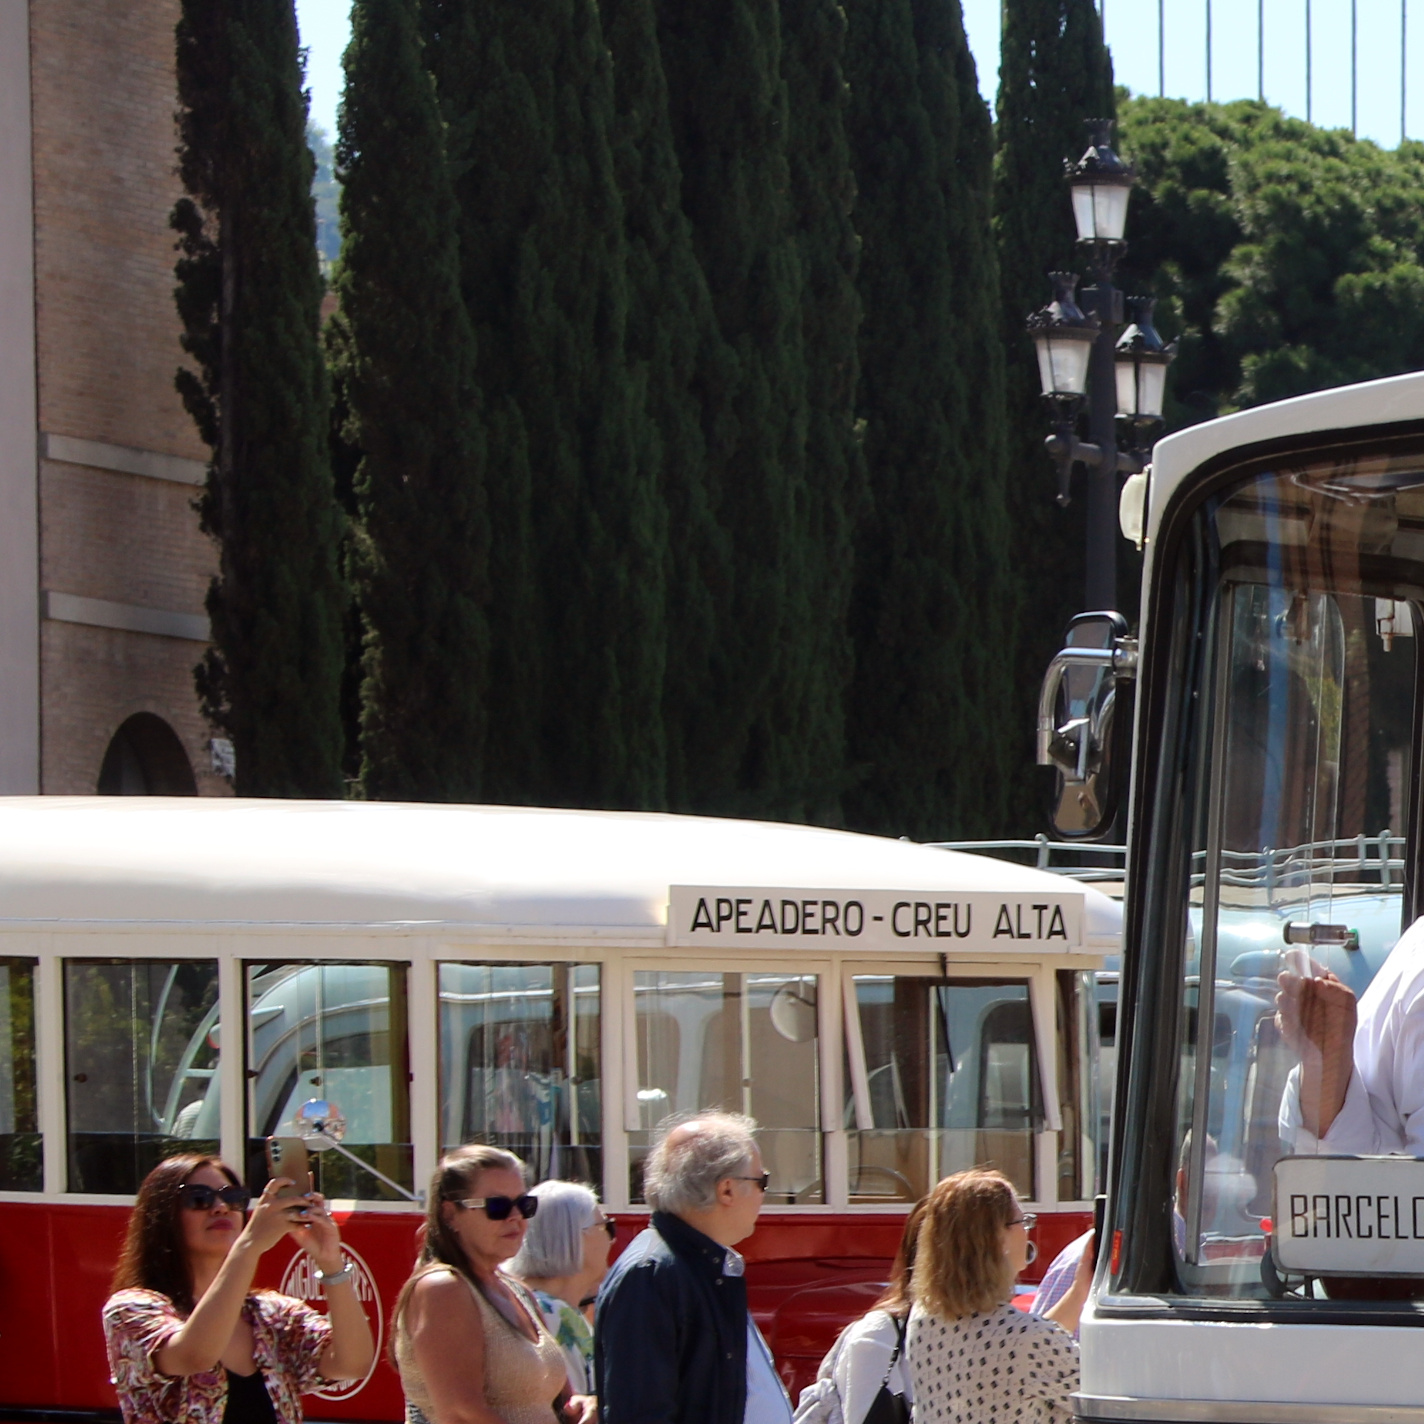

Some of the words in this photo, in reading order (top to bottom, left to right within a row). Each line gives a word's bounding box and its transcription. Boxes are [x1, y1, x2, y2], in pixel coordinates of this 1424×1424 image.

[690, 897, 864, 937] APEADERO
[892, 901, 972, 938] CREU
[992, 903, 1068, 940] ALTA
